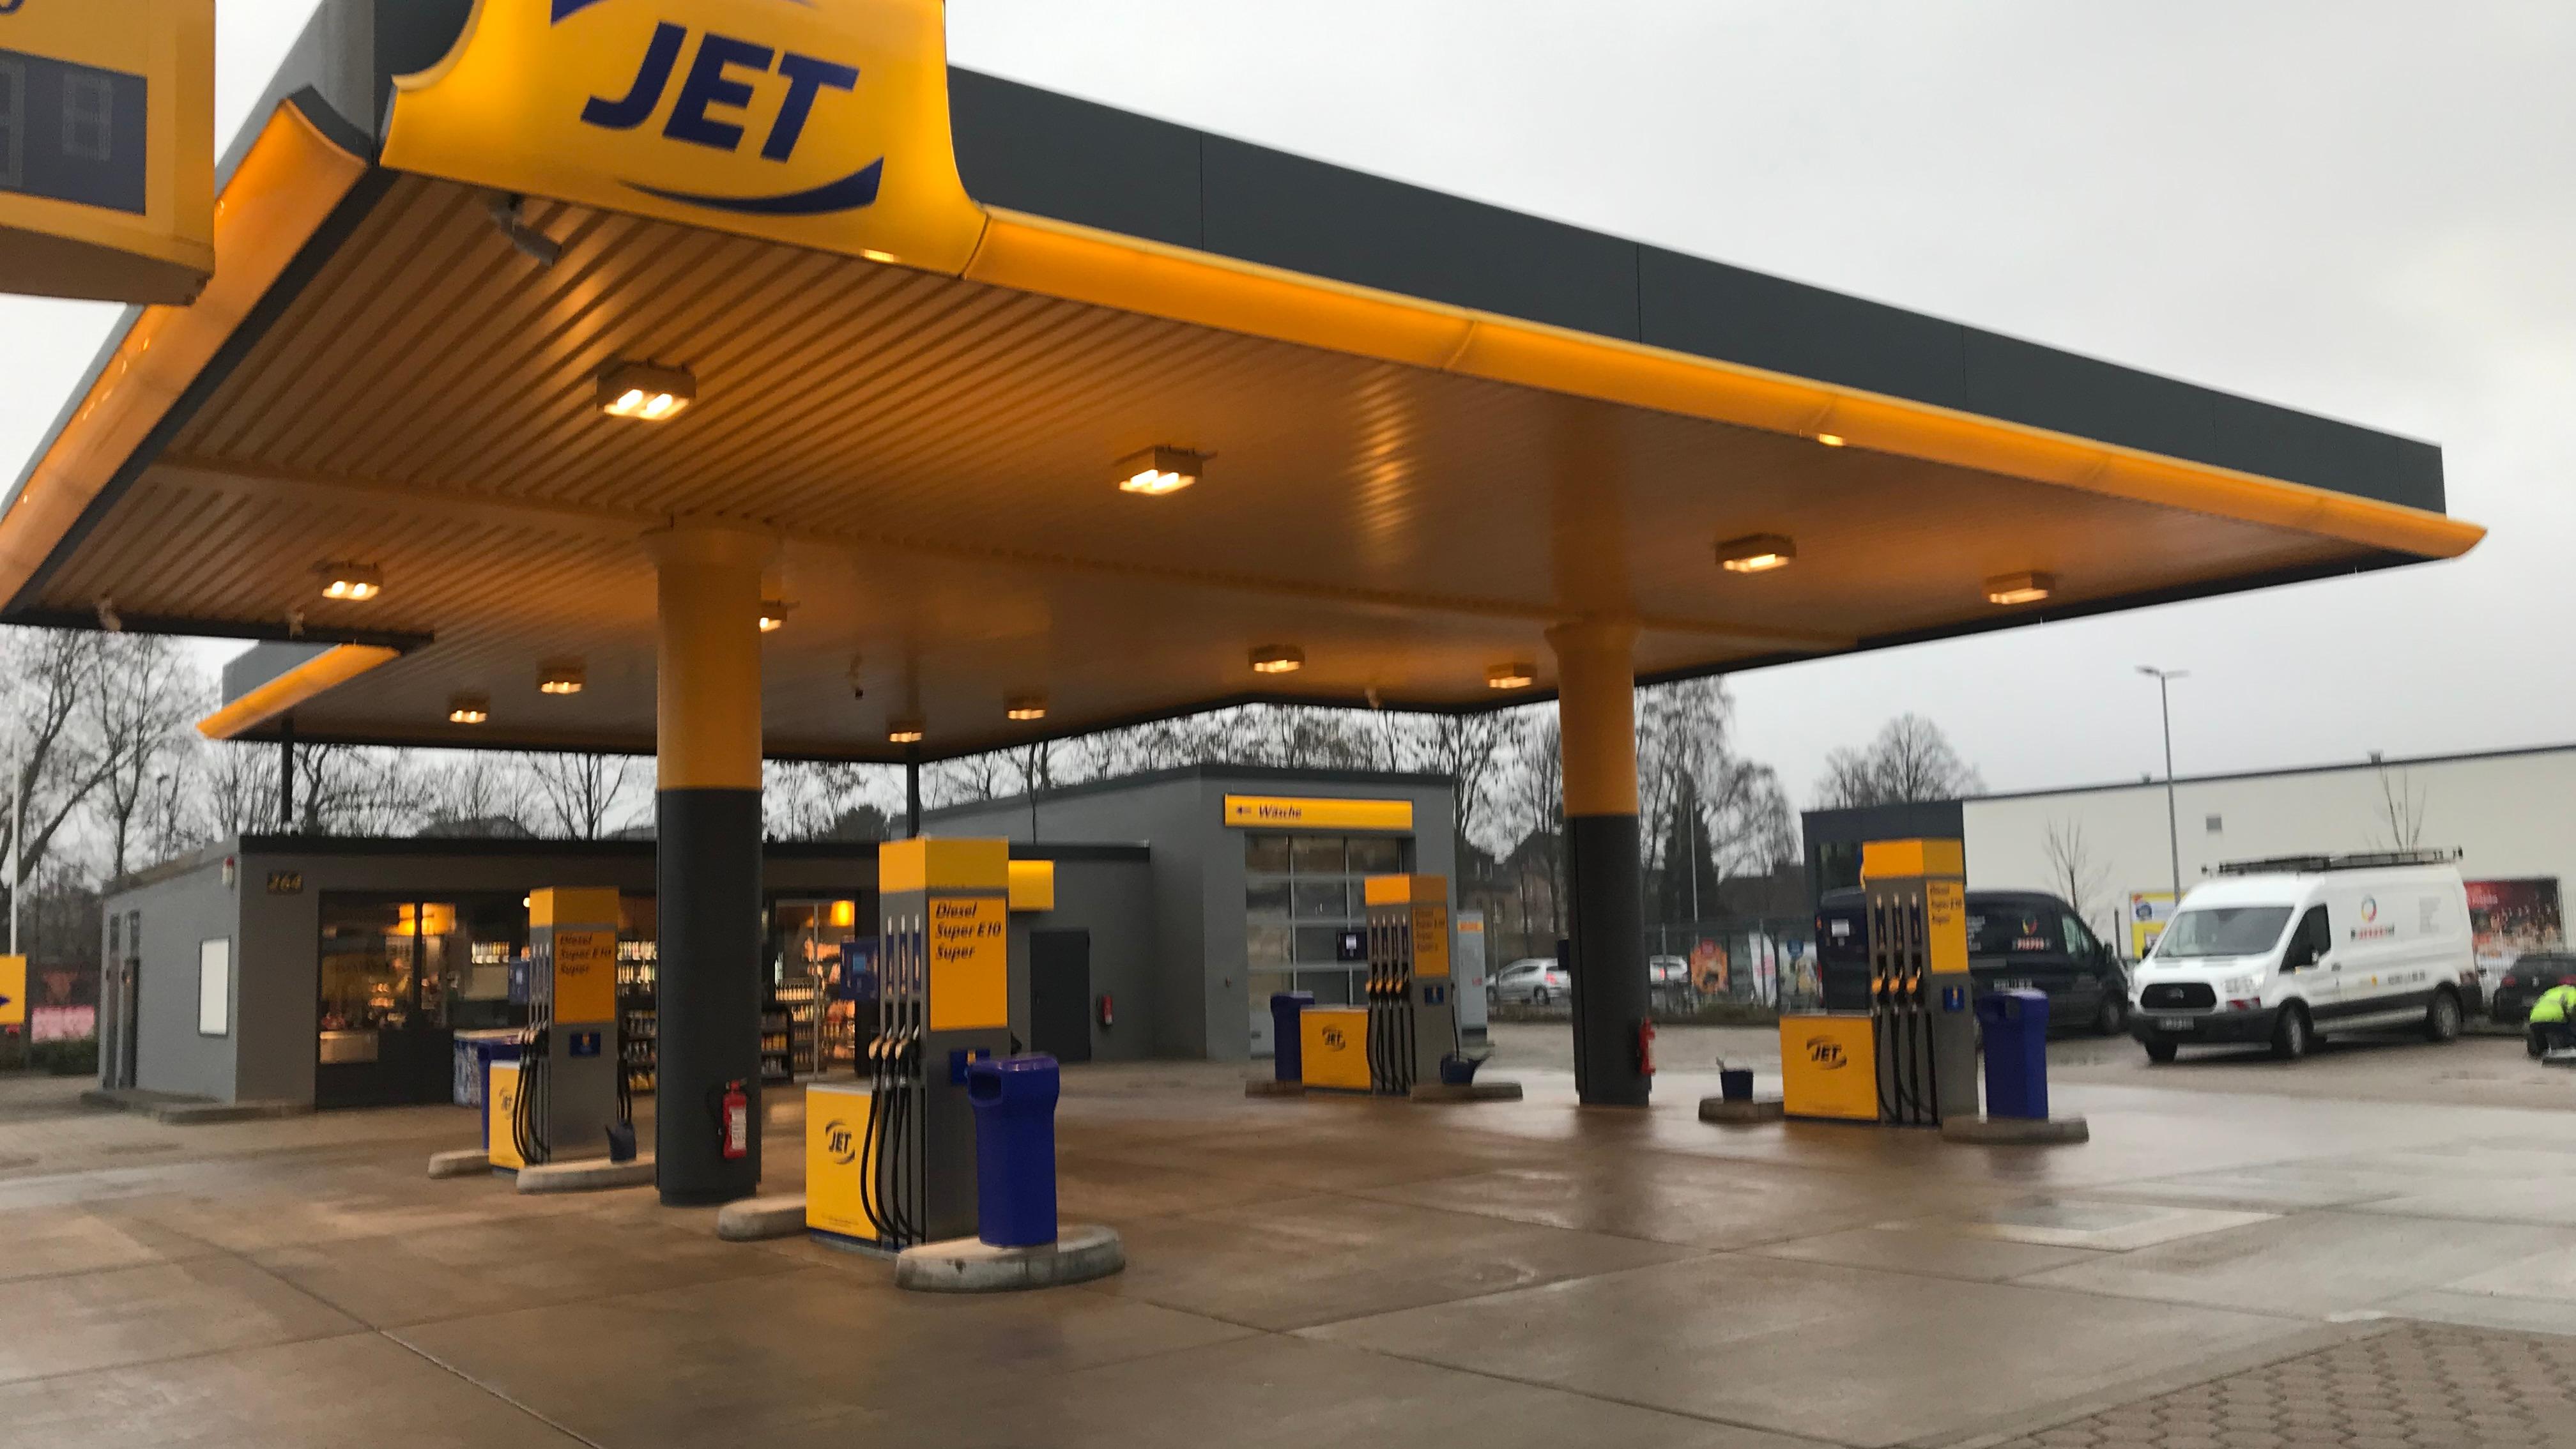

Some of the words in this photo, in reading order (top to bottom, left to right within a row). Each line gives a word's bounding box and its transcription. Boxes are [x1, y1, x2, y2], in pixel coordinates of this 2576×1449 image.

[581, 20, 860, 164] JET
[1259, 803, 1301, 818] Wäsche
[936, 901, 977, 918] Diesel
[935, 922, 975, 942] Super
[976, 921, 1001, 937] E10
[935, 942, 976, 963] Super
[1811, 1043, 1842, 1061] JET
[829, 1130, 852, 1154] JET
